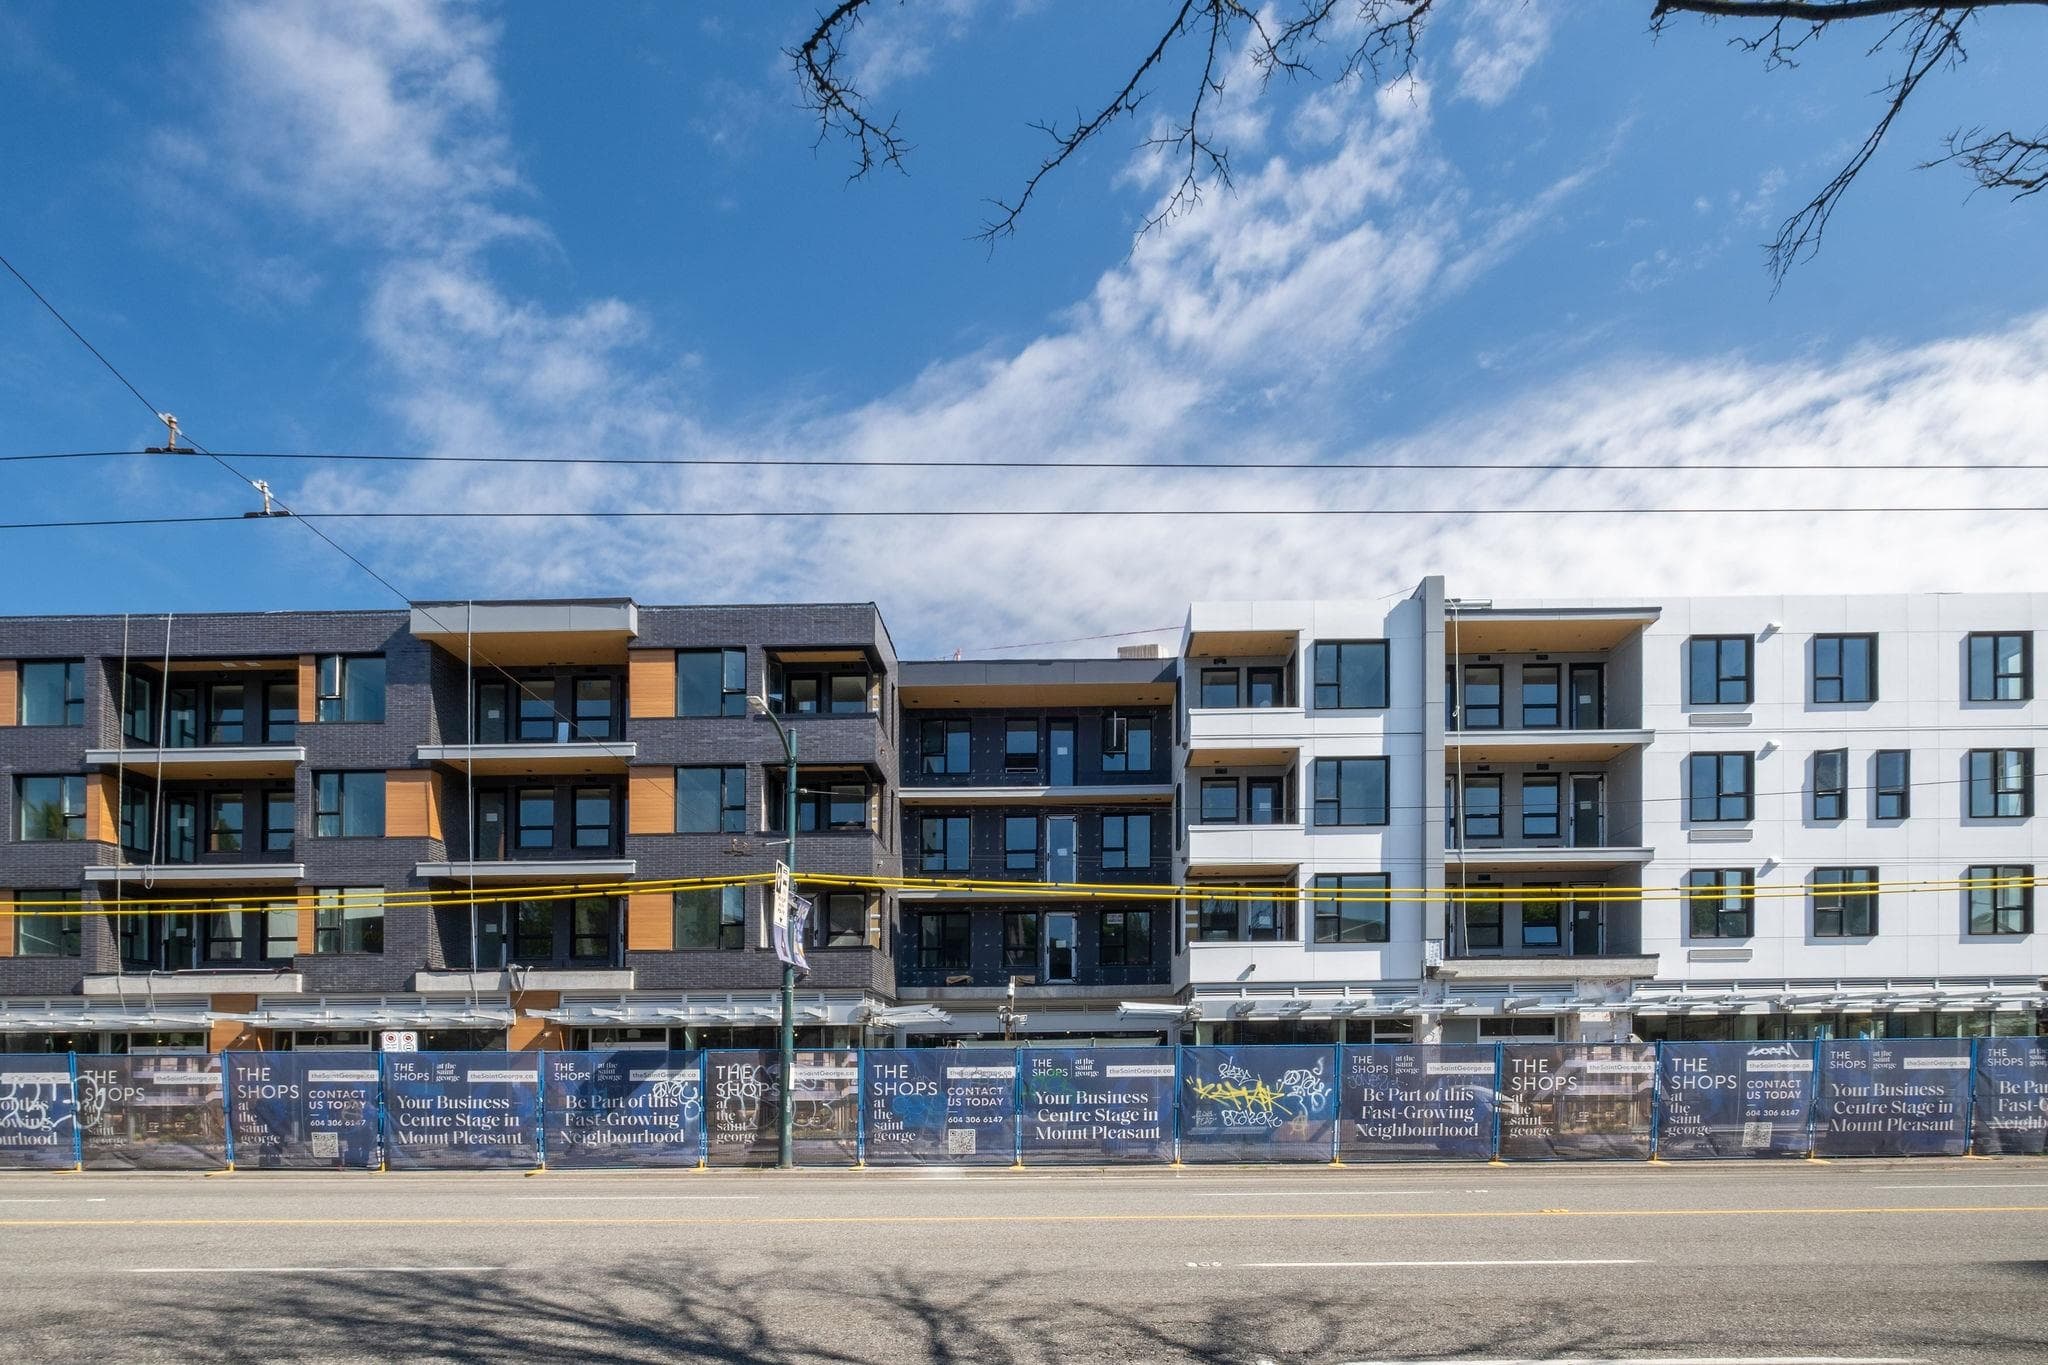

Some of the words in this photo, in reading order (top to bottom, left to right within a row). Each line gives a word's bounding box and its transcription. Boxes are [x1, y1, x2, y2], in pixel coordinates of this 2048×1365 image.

[1830, 1051, 1850, 1059] THE
[1988, 1048, 2008, 1057] THE
[1032, 1059, 1052, 1067] THE
[1352, 1056, 1372, 1064] THE
[1672, 1058, 1708, 1072] THE
[1830, 1061, 1866, 1069] SHOPS
[1988, 1058, 2024, 1067] SHOPS
[394, 1063, 414, 1072] THE
[554, 1062, 575, 1072] THE
[1352, 1065, 1389, 1073] SHOPS
[1512, 1059, 1548, 1073] THE
[1873, 1062, 1897, 1070] george
[84, 1070, 118, 1084] THE
[236, 1068, 271, 1081] THE
[394, 1072, 429, 1081] SHOPS
[554, 1072, 590, 1081] SHOPS
[716, 1065, 751, 1080] THE
[873, 1065, 908, 1079] THE
[1032, 1068, 1068, 1077] SHOPS
[597, 1074, 622, 1082] george
[1512, 1077, 1577, 1090] SHOPS
[1672, 1075, 1737, 1089] SHOPS
[873, 1082, 937, 1096] SHOPS
[1747, 1080, 1801, 1088] CONTACT
[2000, 1080, 2020, 1094] Be
[85, 1087, 145, 1101] SHOPS
[238, 1085, 299, 1098] SHOPS
[309, 1090, 366, 1098] CONTACT
[716, 1083, 781, 1097] SHOPS
[947, 1087, 1004, 1096] CONTACT
[1364, 1088, 1384, 1102] Be
[1388, 1088, 1421, 1102] Part
[1425, 1087, 1442, 1101] of
[1444, 1088, 1474, 1101] this
[1747, 1091, 1761, 1099] US
[1765, 1091, 1801, 1099] TODAY
[1832, 1083, 1870, 1097] Your
[1873, 1083, 1945, 1096] Business
[397, 1096, 433, 1109] Your
[437, 1095, 509, 1109] Business
[566, 1095, 587, 1109] Be
[591, 1095, 625, 1109] Part
[628, 1094, 646, 1108] of
[648, 1093, 678, 1108] this
[948, 1098, 962, 1106] US
[966, 1098, 1004, 1106] TODAY
[1036, 1091, 1072, 1105] Your
[1076, 1091, 1148, 1105] Business
[1670, 1092, 1682, 1102] at
[238, 1102, 249, 1110] at
[309, 1101, 324, 1109] US
[327, 1101, 366, 1109] TODAY
[873, 1099, 885, 1108] at
[1670, 1103, 1690, 1113] the
[1834, 1101, 1888, 1114] Centre
[1891, 1100, 1935, 1117] Stage
[1939, 1100, 1953, 1113] in
[239, 1112, 257, 1123] the
[716, 1109, 736, 1121] the
[873, 1109, 893, 1120] the
[1038, 1109, 1091, 1122] Centre
[1094, 1108, 1140, 1125] Stage
[1144, 1108, 1158, 1121] in
[1362, 1105, 1475, 1122] Fast-Growing
[1670, 1114, 1701, 1124] saint
[400, 1113, 452, 1127] Centre
[456, 1113, 500, 1130] Stage
[504, 1113, 520, 1126] in
[565, 1112, 680, 1128] Fast-Growing
[874, 1120, 904, 1130] saint
[1510, 1115, 1541, 1125] saint
[1830, 1119, 1882, 1132] Mount
[1888, 1118, 1954, 1131] Pleasant
[239, 1123, 268, 1133] saint
[716, 1121, 747, 1131] saint
[1356, 1123, 1479, 1140] Neighbourhood
[1667, 1125, 1712, 1137] george
[398, 1131, 448, 1145] Mount
[453, 1130, 523, 1145] Pleasant
[560, 1129, 684, 1146] Neighbourhood
[873, 1131, 916, 1143] george
[1036, 1127, 1087, 1140] Mount
[1092, 1126, 1160, 1139] Pleasant
[1509, 1127, 1554, 1138] george
[241, 1135, 280, 1146] george
[716, 1133, 758, 1144] george
